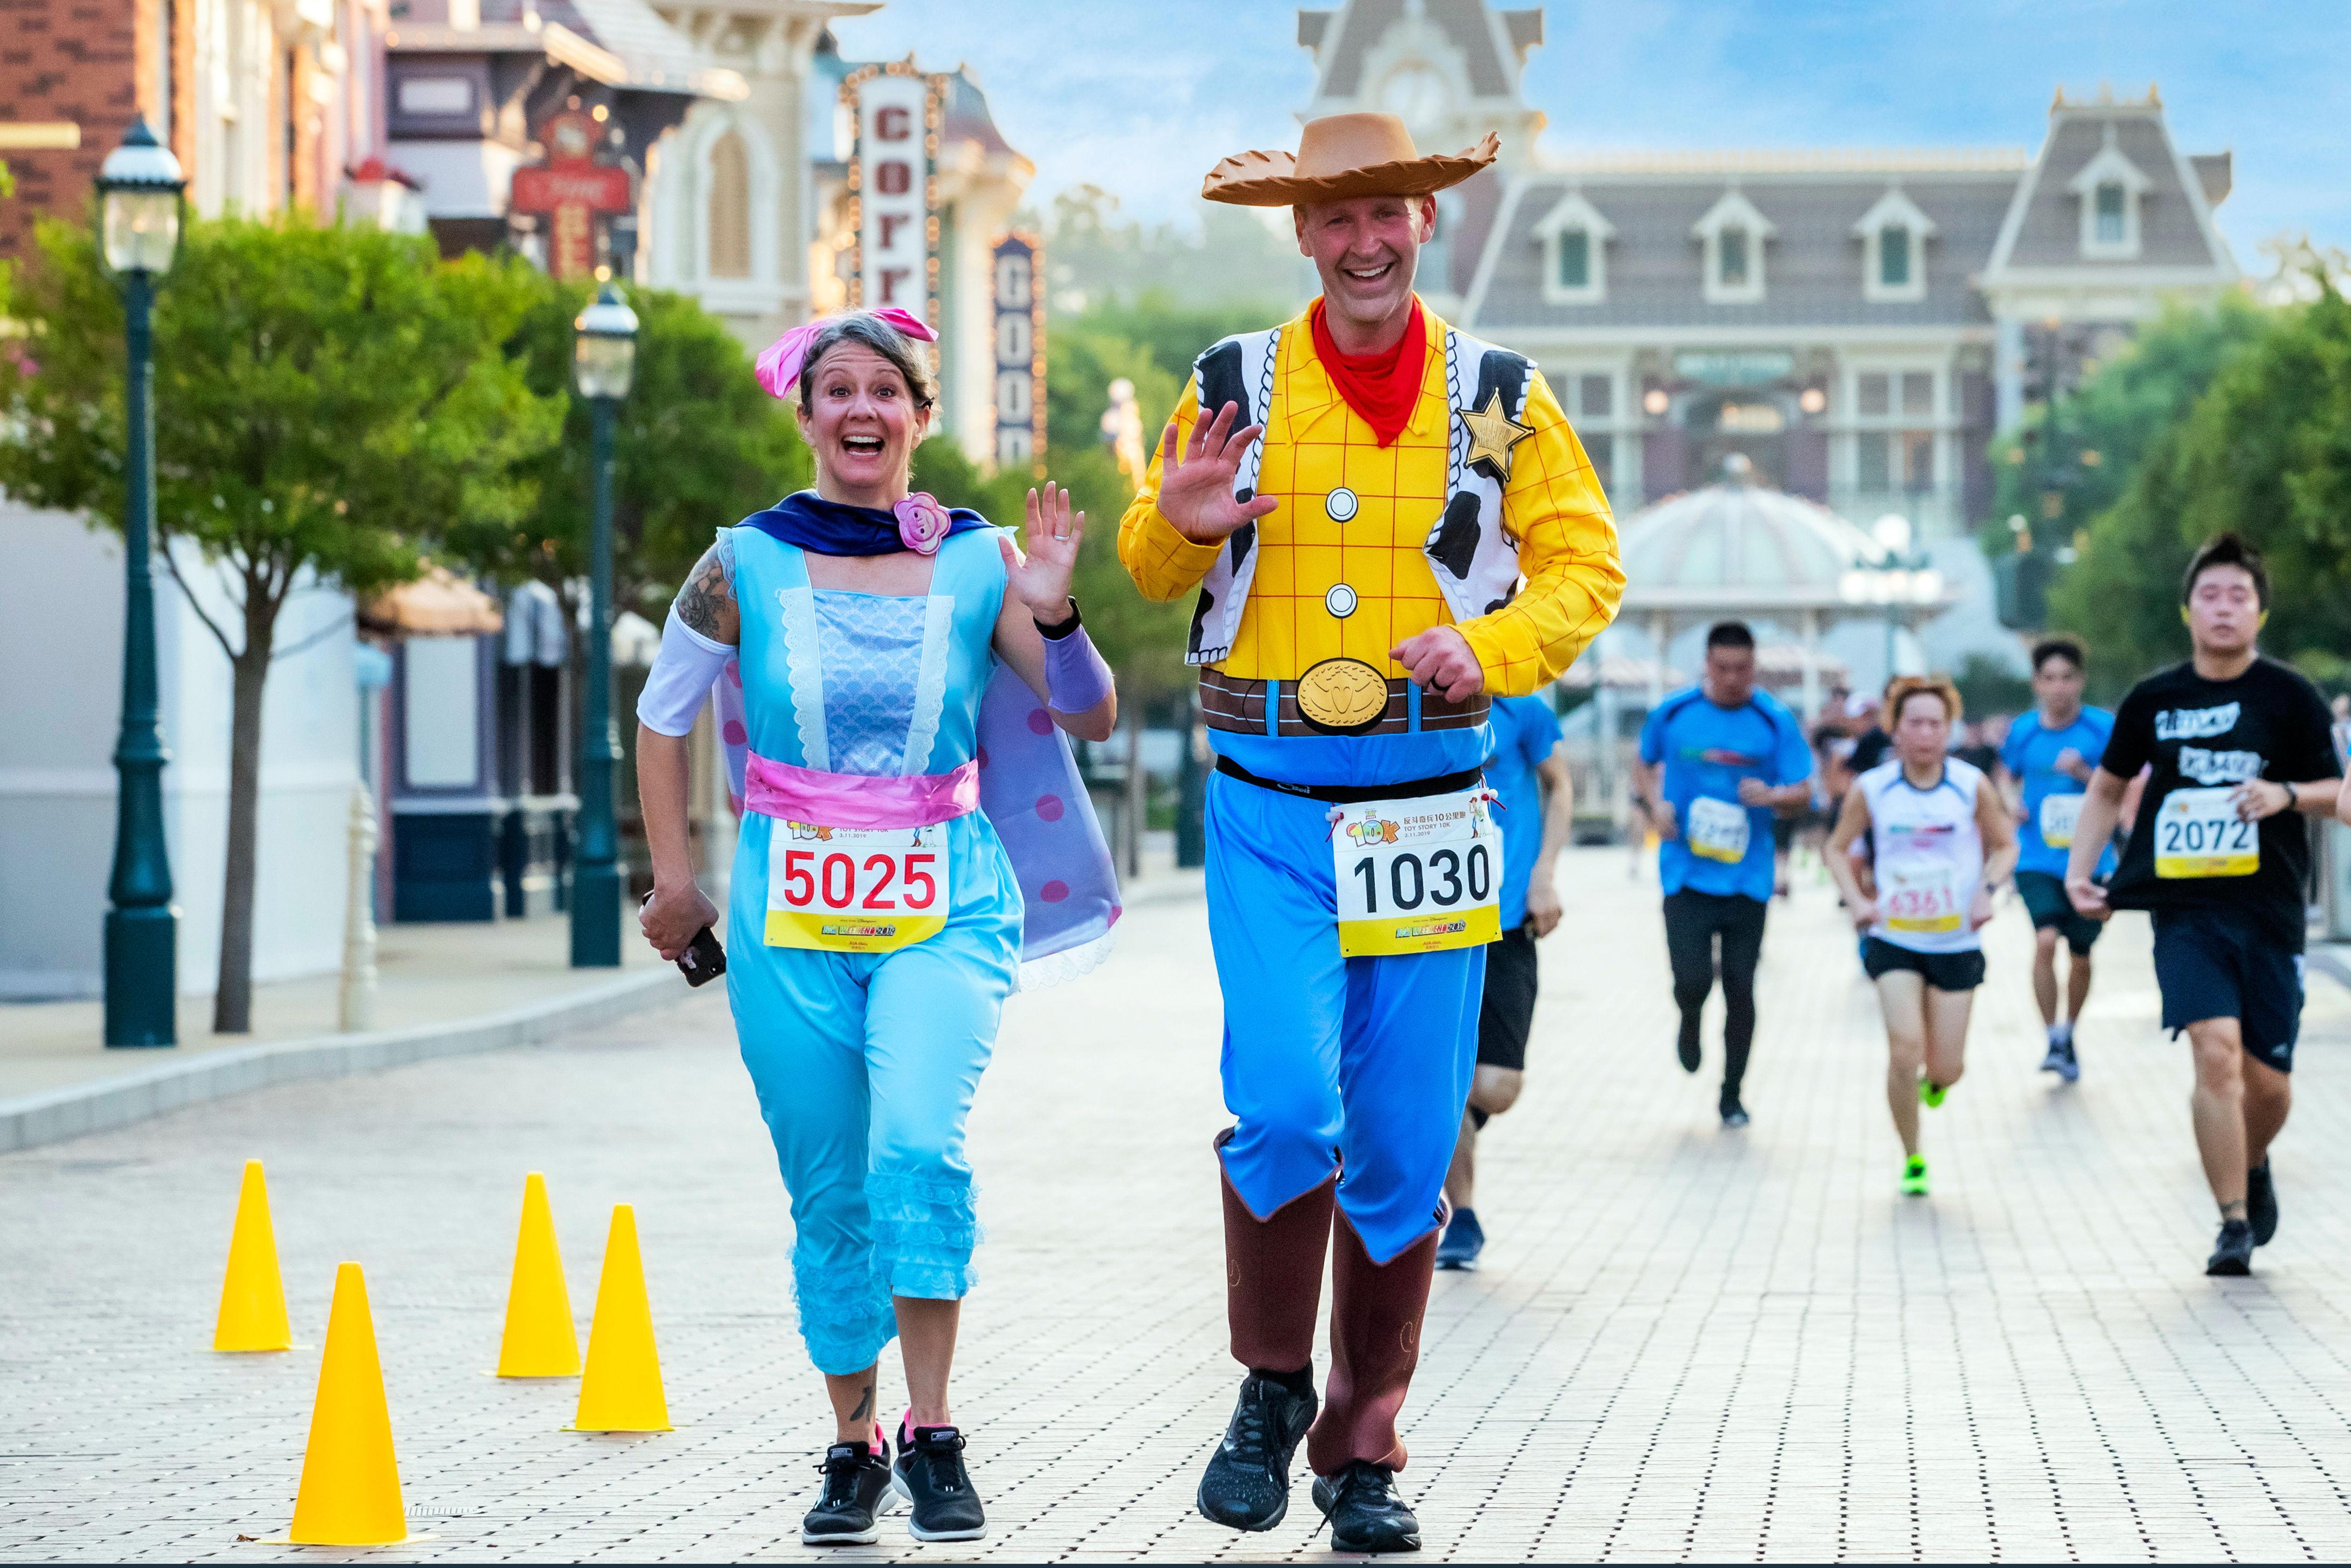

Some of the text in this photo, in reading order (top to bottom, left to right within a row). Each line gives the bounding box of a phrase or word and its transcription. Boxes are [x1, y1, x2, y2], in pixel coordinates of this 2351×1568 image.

[1346, 819, 1400, 848] 10K
[2165, 820, 2249, 852] 2072
[784, 850, 936, 909] 5025
[1354, 844, 1490, 913] 1030
[838, 925, 875, 936] WEEKEND
[875, 924, 896, 936] 2019
[1412, 923, 1447, 936] WEEKEND
[1448, 918, 1466, 933] 2019
